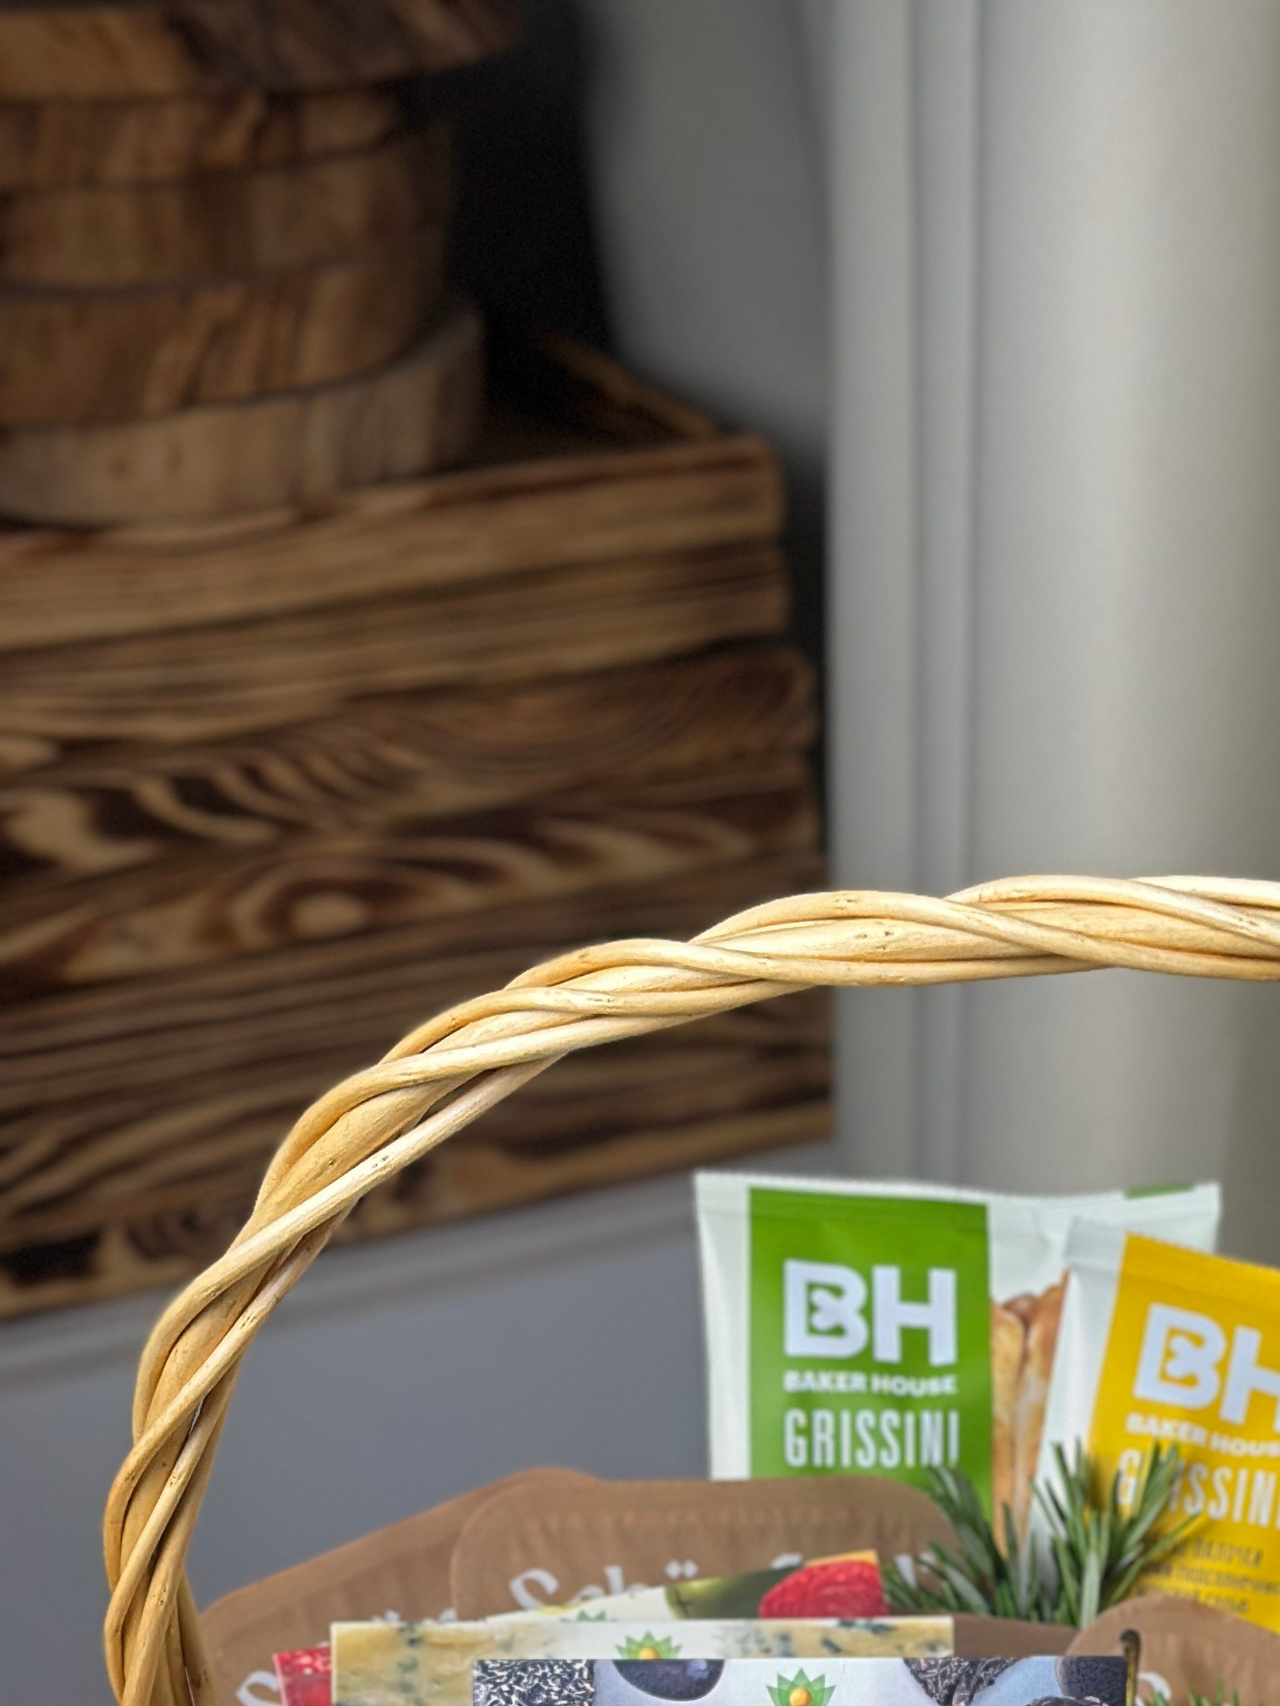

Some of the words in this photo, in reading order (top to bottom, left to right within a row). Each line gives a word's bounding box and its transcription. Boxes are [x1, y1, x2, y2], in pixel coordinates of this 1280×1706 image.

[784, 1258, 957, 1367] BH
[784, 1370, 867, 1394] BAKER
[871, 1373, 958, 1398] HOUSE
[784, 1408, 960, 1470] GRISSINI
[1125, 1412, 1208, 1446] BAKER
